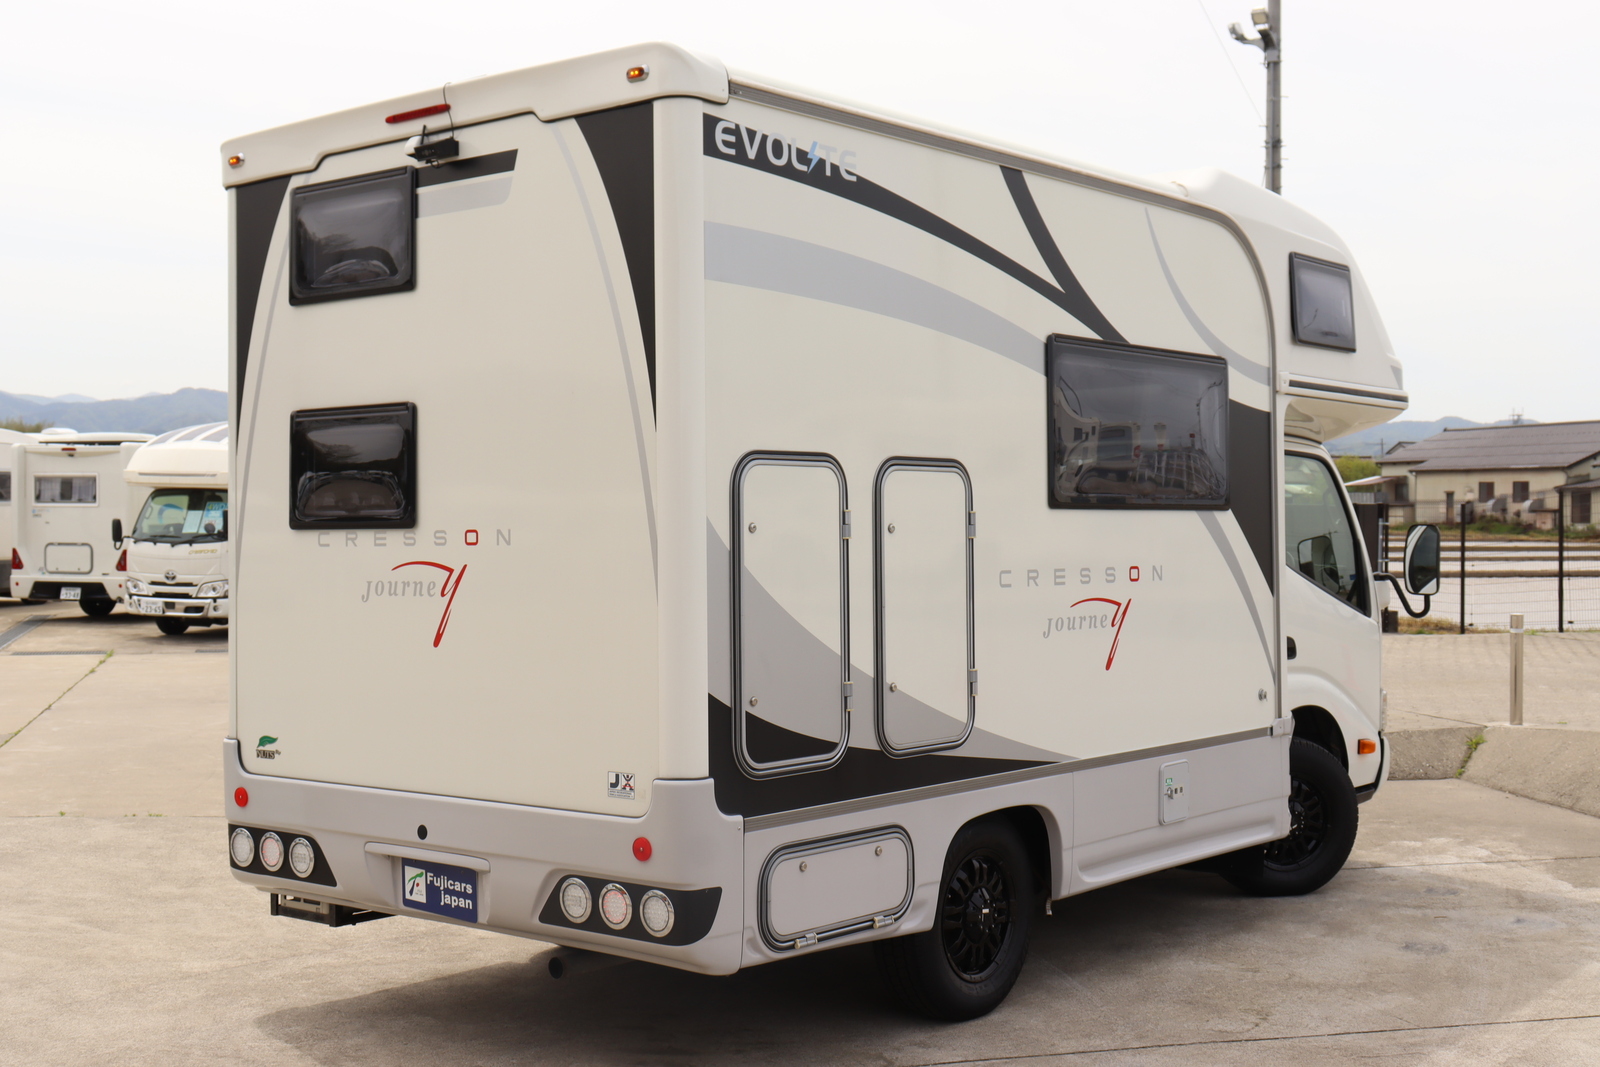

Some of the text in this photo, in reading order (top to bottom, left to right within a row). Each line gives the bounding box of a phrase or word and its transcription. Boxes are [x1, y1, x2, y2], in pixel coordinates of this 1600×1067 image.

[317, 528, 511, 548] CRESSON
[999, 565, 1163, 588] CRESSON
[256, 749, 275, 760] NUTS
[426, 872, 473, 894] Fujicars
[440, 891, 473, 910] japan
